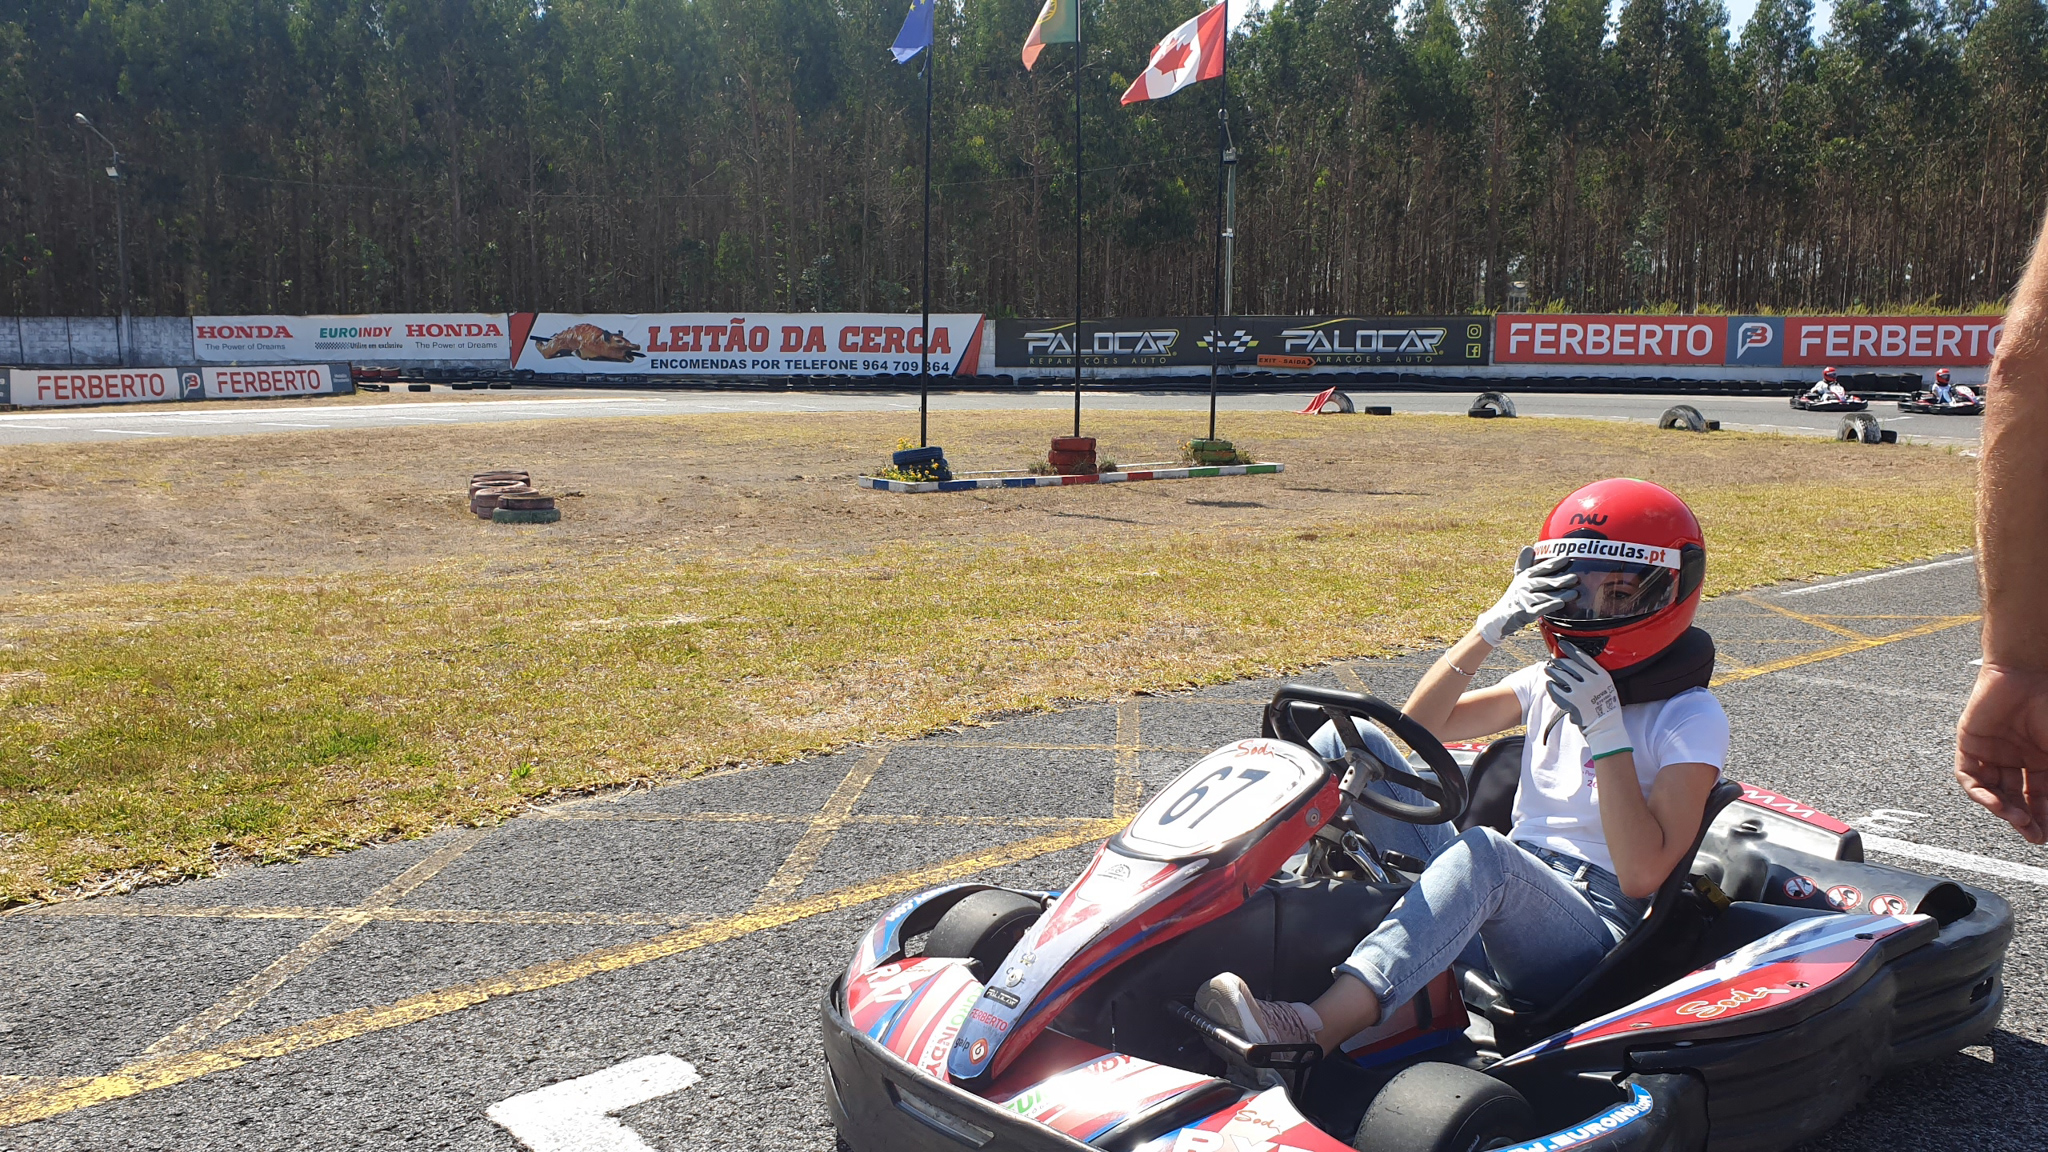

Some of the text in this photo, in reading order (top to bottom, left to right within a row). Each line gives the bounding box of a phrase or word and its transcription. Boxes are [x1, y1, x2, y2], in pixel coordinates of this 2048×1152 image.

[196, 325, 294, 339] HONDA
[319, 326, 393, 338] EUROINDY
[405, 323, 503, 337] HONDA
[647, 317, 951, 354] LEITÃO DA CERCA
[1280, 330, 1444, 353] PALOCAR
[1509, 323, 1713, 356] FERBERTO
[415, 341, 430, 349] The
[432, 341, 456, 349] Power
[467, 341, 498, 349] Dreams
[1023, 331, 1177, 355] PALOCAR
[650, 358, 747, 370] ENCOMENDAS
[751, 358, 781, 370] POR
[784, 359, 858, 370] TELEFONE
[862, 360, 889, 371] 964
[892, 361, 919, 372] 709
[1029, 355, 1167, 366] REPARÇÕES AUTO
[37, 373, 165, 400] FERBERTO
[216, 369, 321, 394] FERBERTO
[1158, 765, 1270, 829] 67
[969, 1008, 1009, 1032] FERBERTO
[953, 1037, 970, 1052] galp
[1234, 1110, 1281, 1134] Sodi
